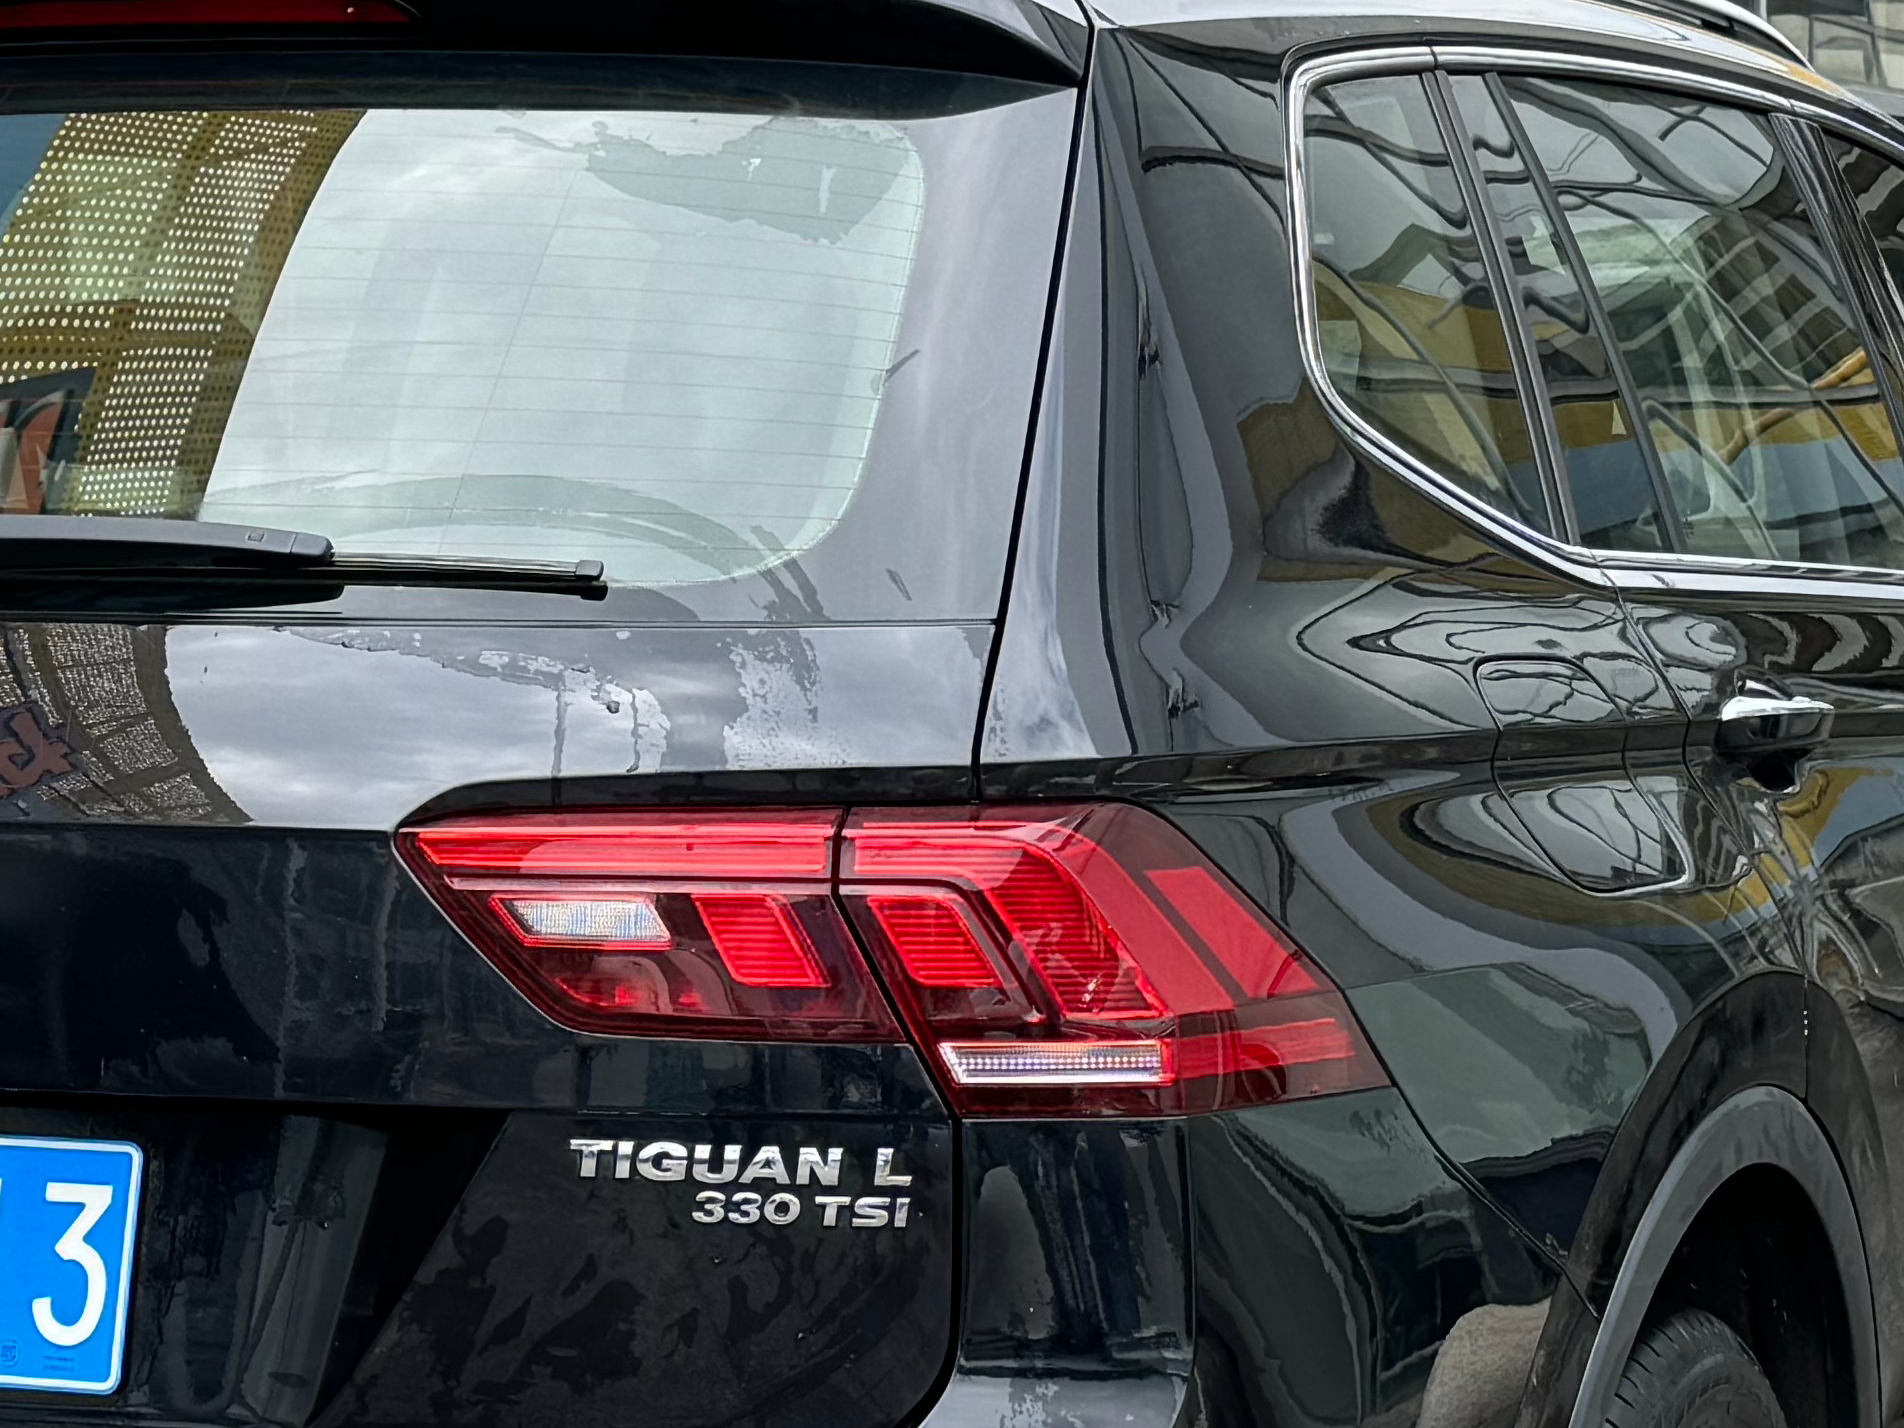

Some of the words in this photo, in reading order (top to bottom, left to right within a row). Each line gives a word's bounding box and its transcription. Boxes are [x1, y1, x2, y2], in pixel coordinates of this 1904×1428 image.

[569, 1138, 844, 1186] TIGUAN
[873, 1146, 913, 1186] L
[691, 1190, 801, 1225] 330
[814, 1195, 911, 1228] TSI
